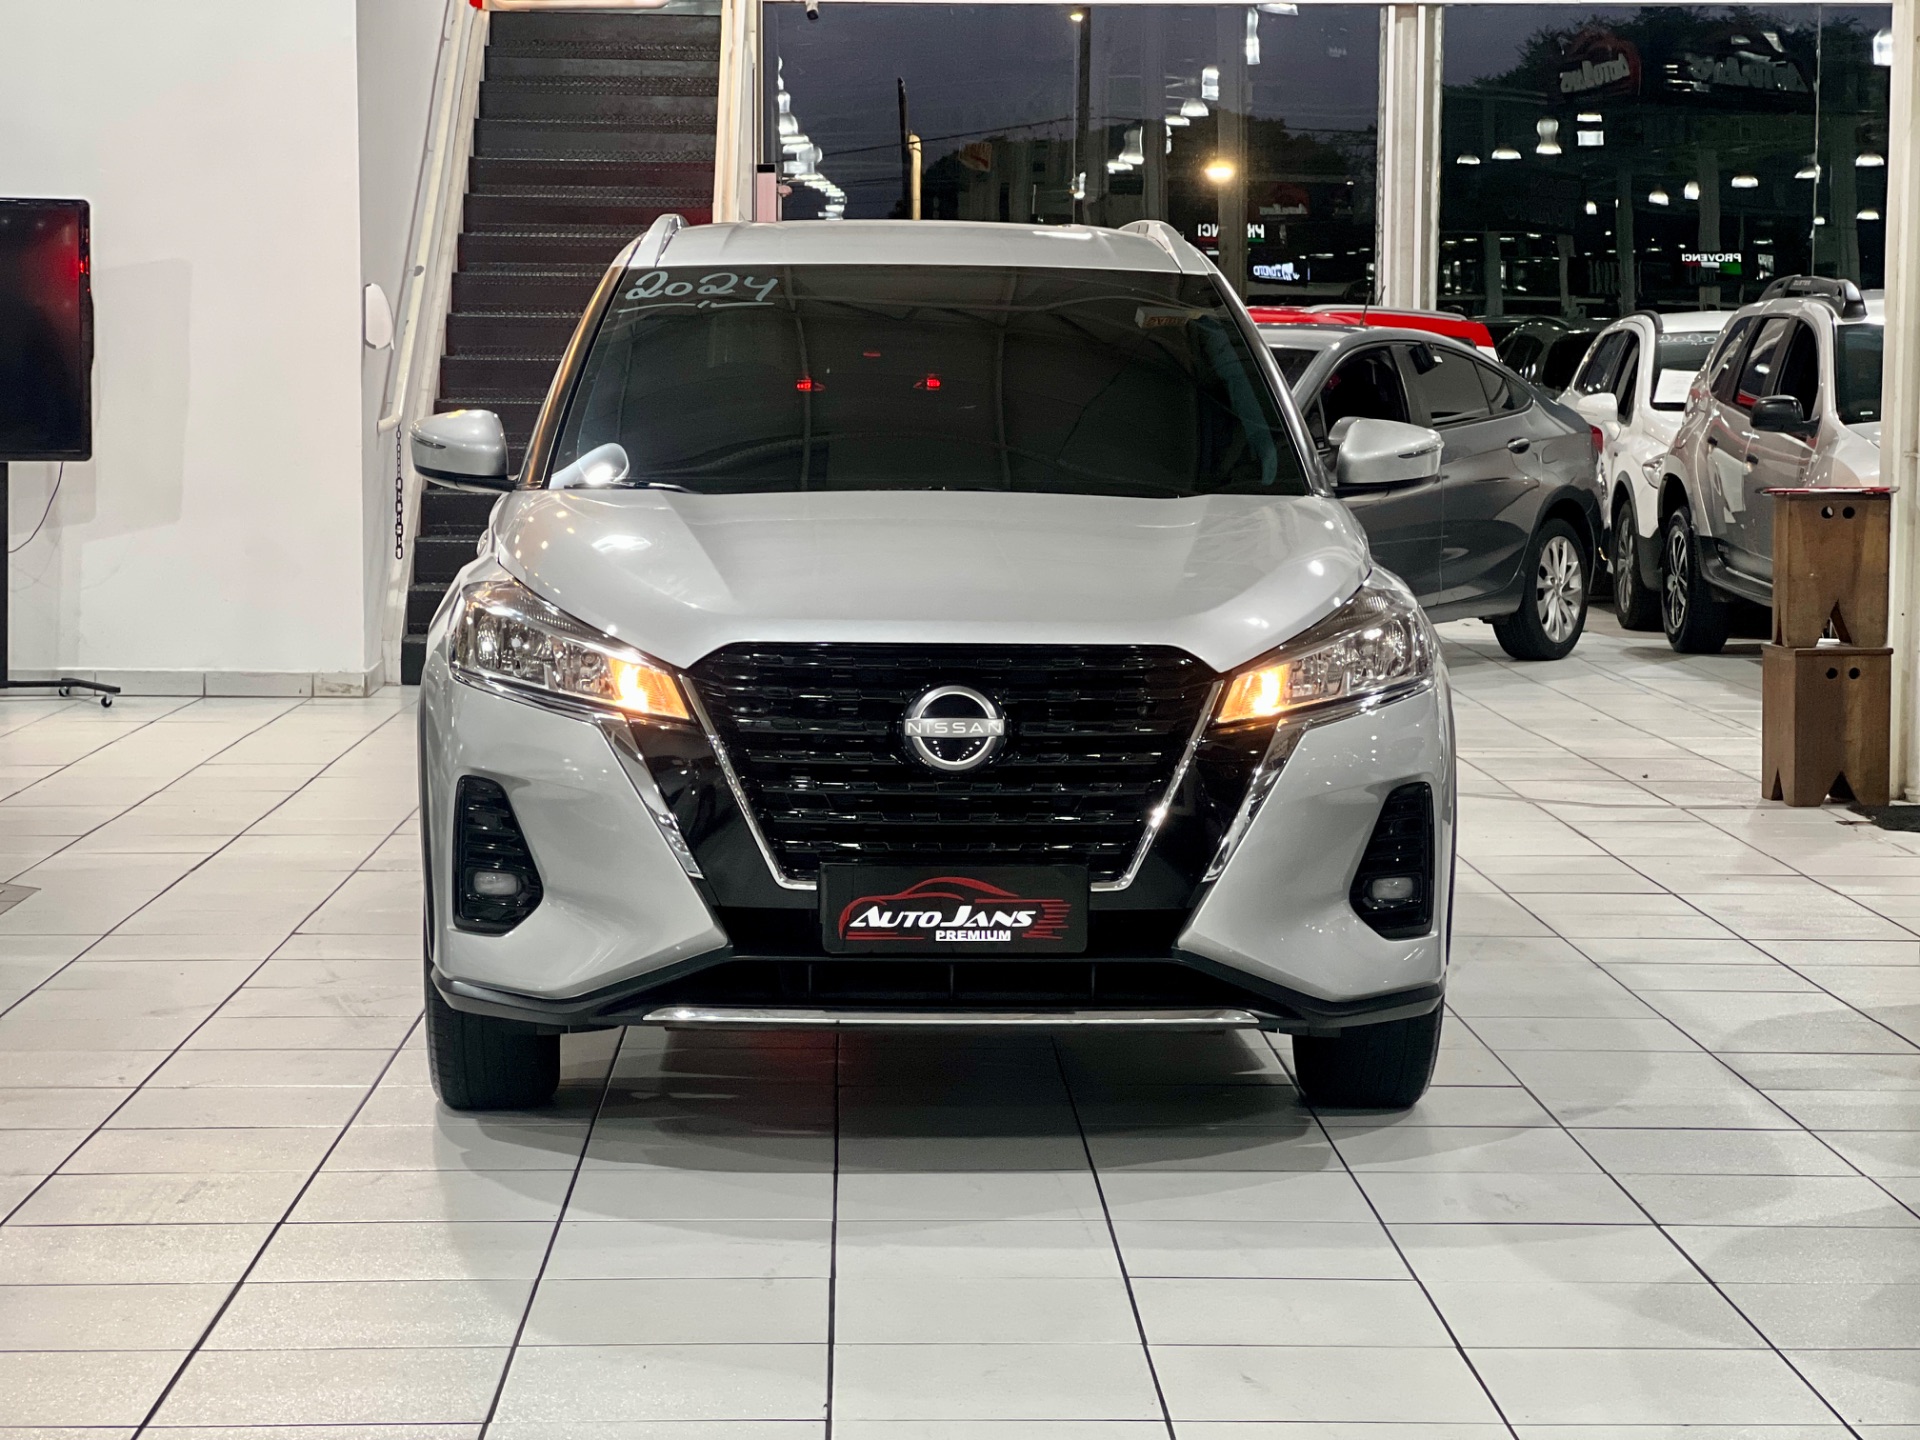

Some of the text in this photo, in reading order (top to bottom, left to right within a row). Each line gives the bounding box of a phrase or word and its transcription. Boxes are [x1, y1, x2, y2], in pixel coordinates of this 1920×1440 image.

[625, 270, 778, 301] 2024
[907, 722, 1002, 734] NISSAN
[935, 929, 1012, 942] PREMIUM
